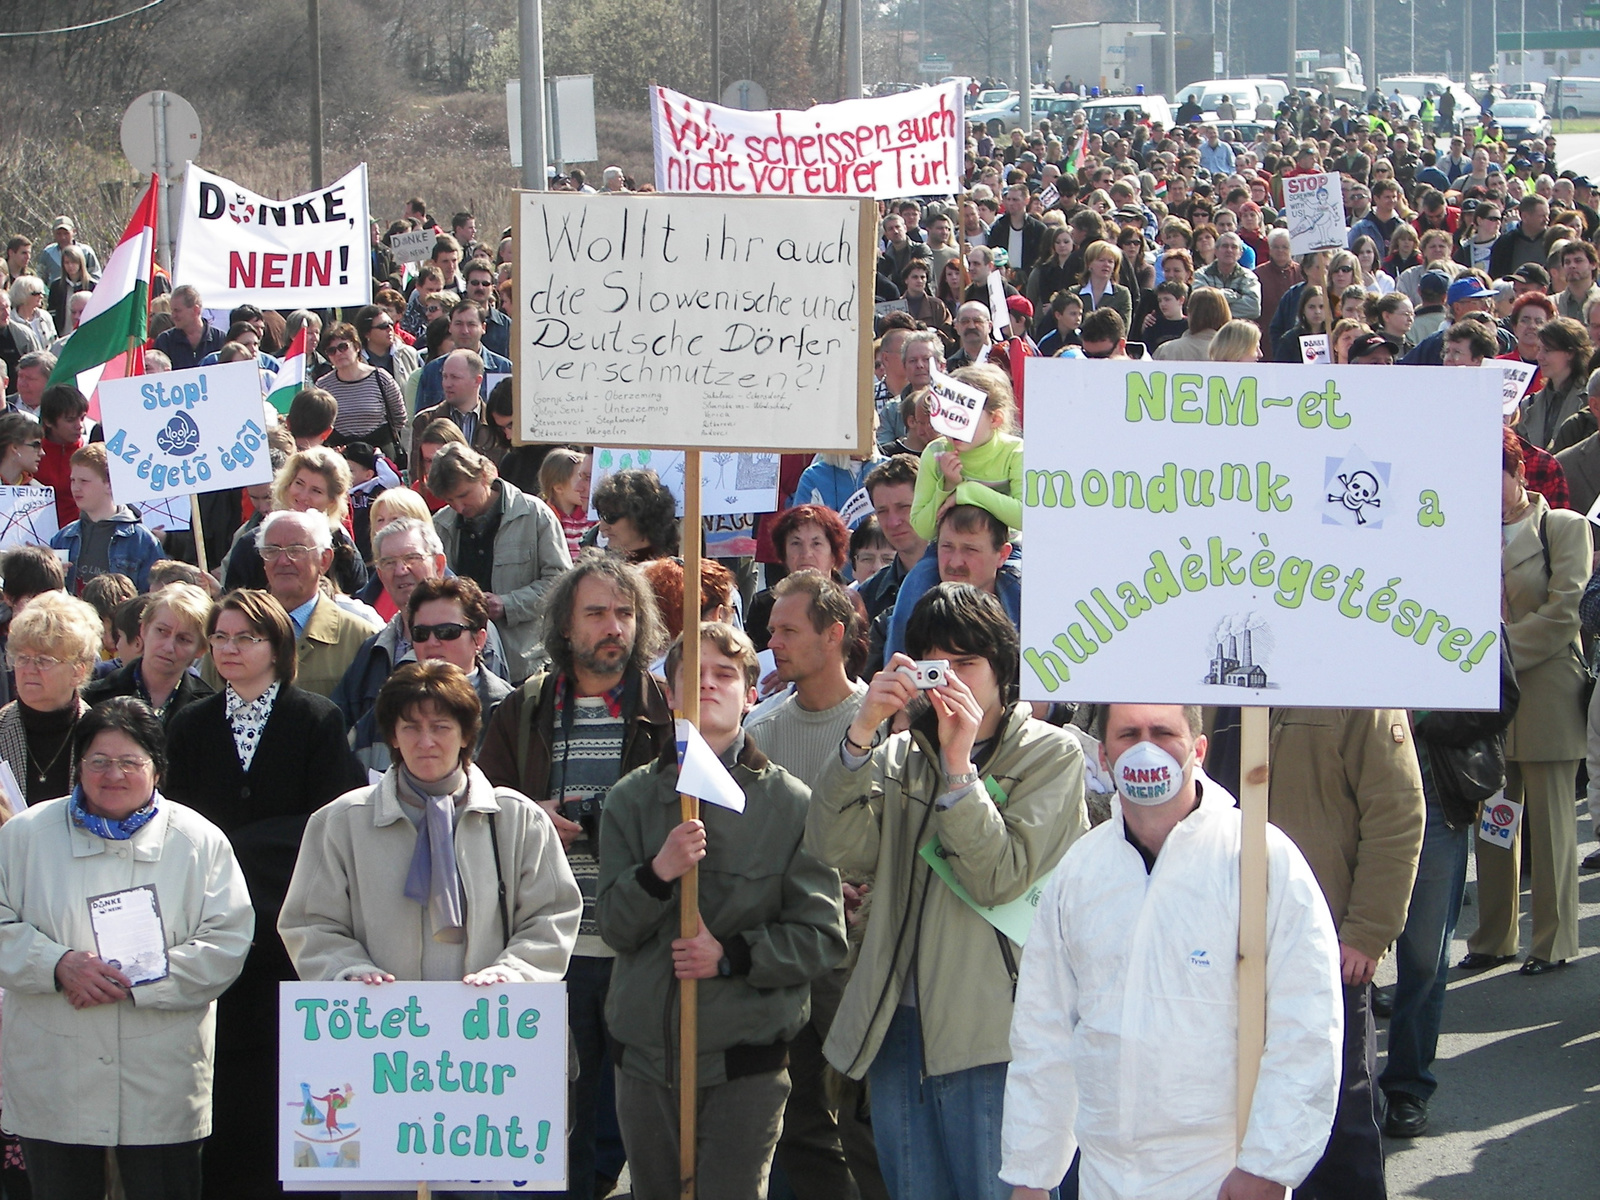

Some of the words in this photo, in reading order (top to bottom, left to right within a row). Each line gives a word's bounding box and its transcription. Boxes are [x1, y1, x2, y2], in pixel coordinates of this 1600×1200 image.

[658, 88, 734, 152] Wir
[745, 112, 891, 167] scheissen
[898, 93, 955, 143] auch
[668, 149, 746, 191] nicht
[747, 153, 801, 194] vor
[804, 160, 883, 194] eurer
[881, 141, 950, 189] Tür!
[1288, 175, 1328, 193] STOP
[542, 204, 679, 263] Wollt
[704, 213, 764, 263] ihr
[776, 218, 852, 266] auch
[229, 245, 350, 289] NEIN!
[530, 273, 586, 316] die
[599, 270, 792, 316] Slowenische
[801, 280, 855, 322] und
[532, 318, 703, 356] Deutsche
[719, 322, 841, 360] Dörfer
[140, 374, 208, 410] Stop!
[105, 428, 141, 464] Az
[1024, 461, 1292, 513] mondunk
[1417, 489, 1445, 527] a
[1123, 766, 1170, 783] DANKE
[1125, 780, 1171, 798] NEIN!
[92, 897, 121, 909] DANKE
[295, 995, 430, 1041] Tötet
[462, 994, 541, 1041] die
[373, 1050, 516, 1096] Natur
[396, 1112, 551, 1165] nicht!
